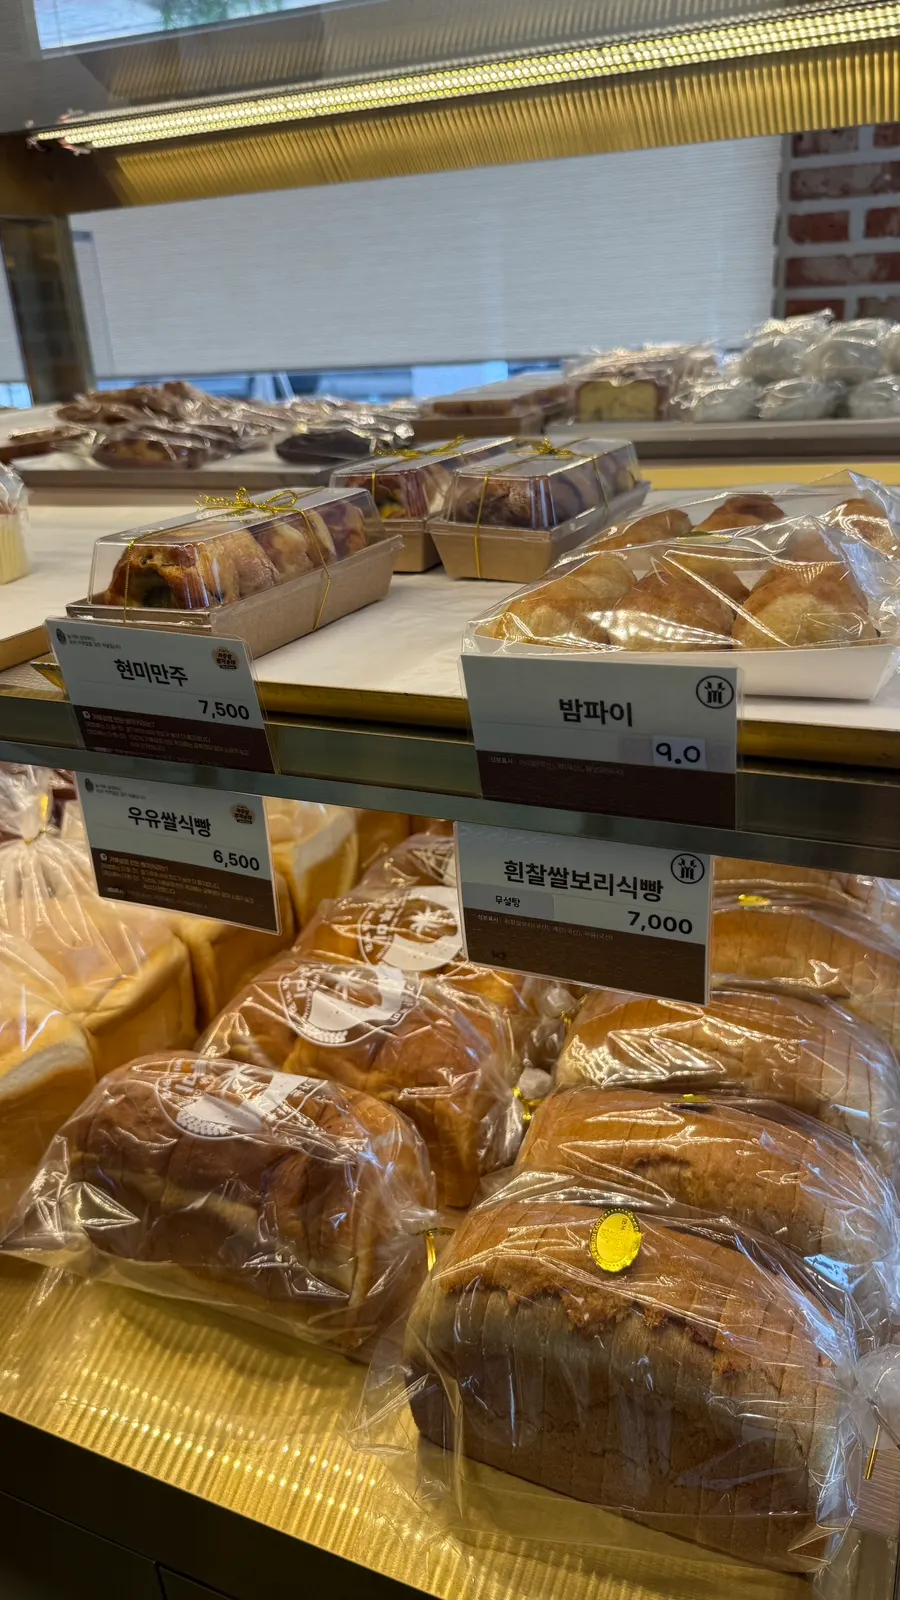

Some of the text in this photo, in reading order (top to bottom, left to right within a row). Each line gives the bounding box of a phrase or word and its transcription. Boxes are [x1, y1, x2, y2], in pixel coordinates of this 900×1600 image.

[114, 658, 188, 687] 현미만주
[198, 699, 250, 720] 7,500
[559, 698, 633, 727] 밤파이
[655, 742, 701, 764] 9.0
[128, 806, 211, 838] 우유쌀식빵
[213, 850, 260, 871] 6,500
[503, 859, 664, 903] 흰찰쌀보리식빵
[495, 895, 521, 908] 무설탕
[627, 910, 693, 935] 7,000
